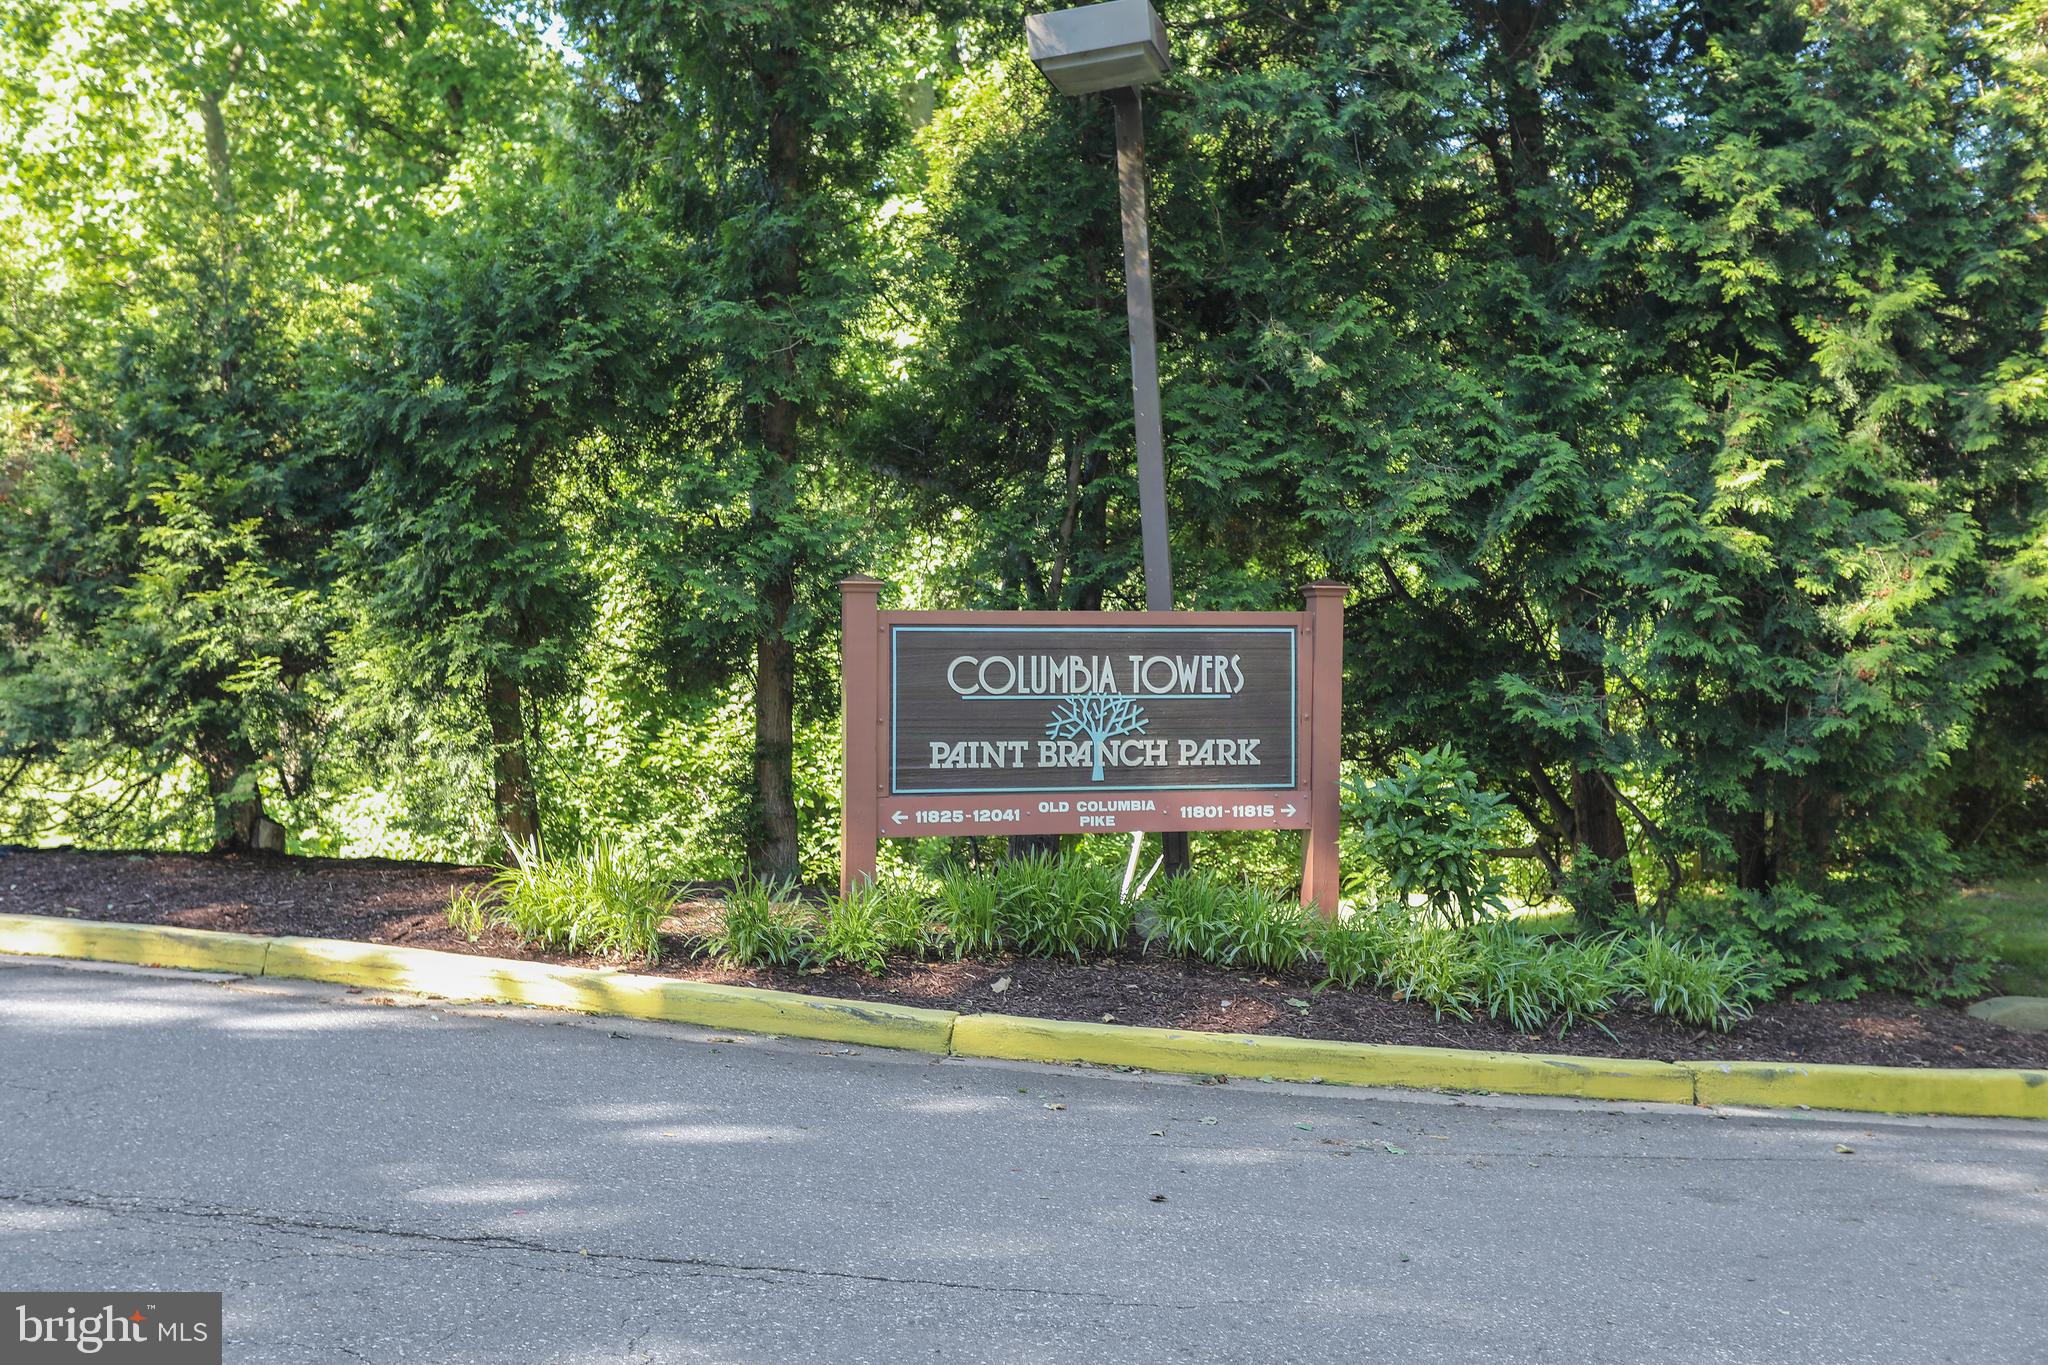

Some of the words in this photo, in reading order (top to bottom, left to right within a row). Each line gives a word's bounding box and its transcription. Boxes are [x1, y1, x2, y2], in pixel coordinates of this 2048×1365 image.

[947, 655, 1117, 694] COLUMBIA
[1129, 654, 1245, 694] TOWERS
[929, 741, 1029, 768] PAINT
[1038, 739, 1168, 767] BRANCH
[1178, 738, 1261, 766] PARK
[1038, 802, 1069, 813] OLD
[1076, 800, 1156, 812] COLUMBIA
[1180, 805, 1275, 818] 11801-11815
[915, 809, 1020, 823] 11825-12041
[1079, 815, 1116, 827] PIKE
